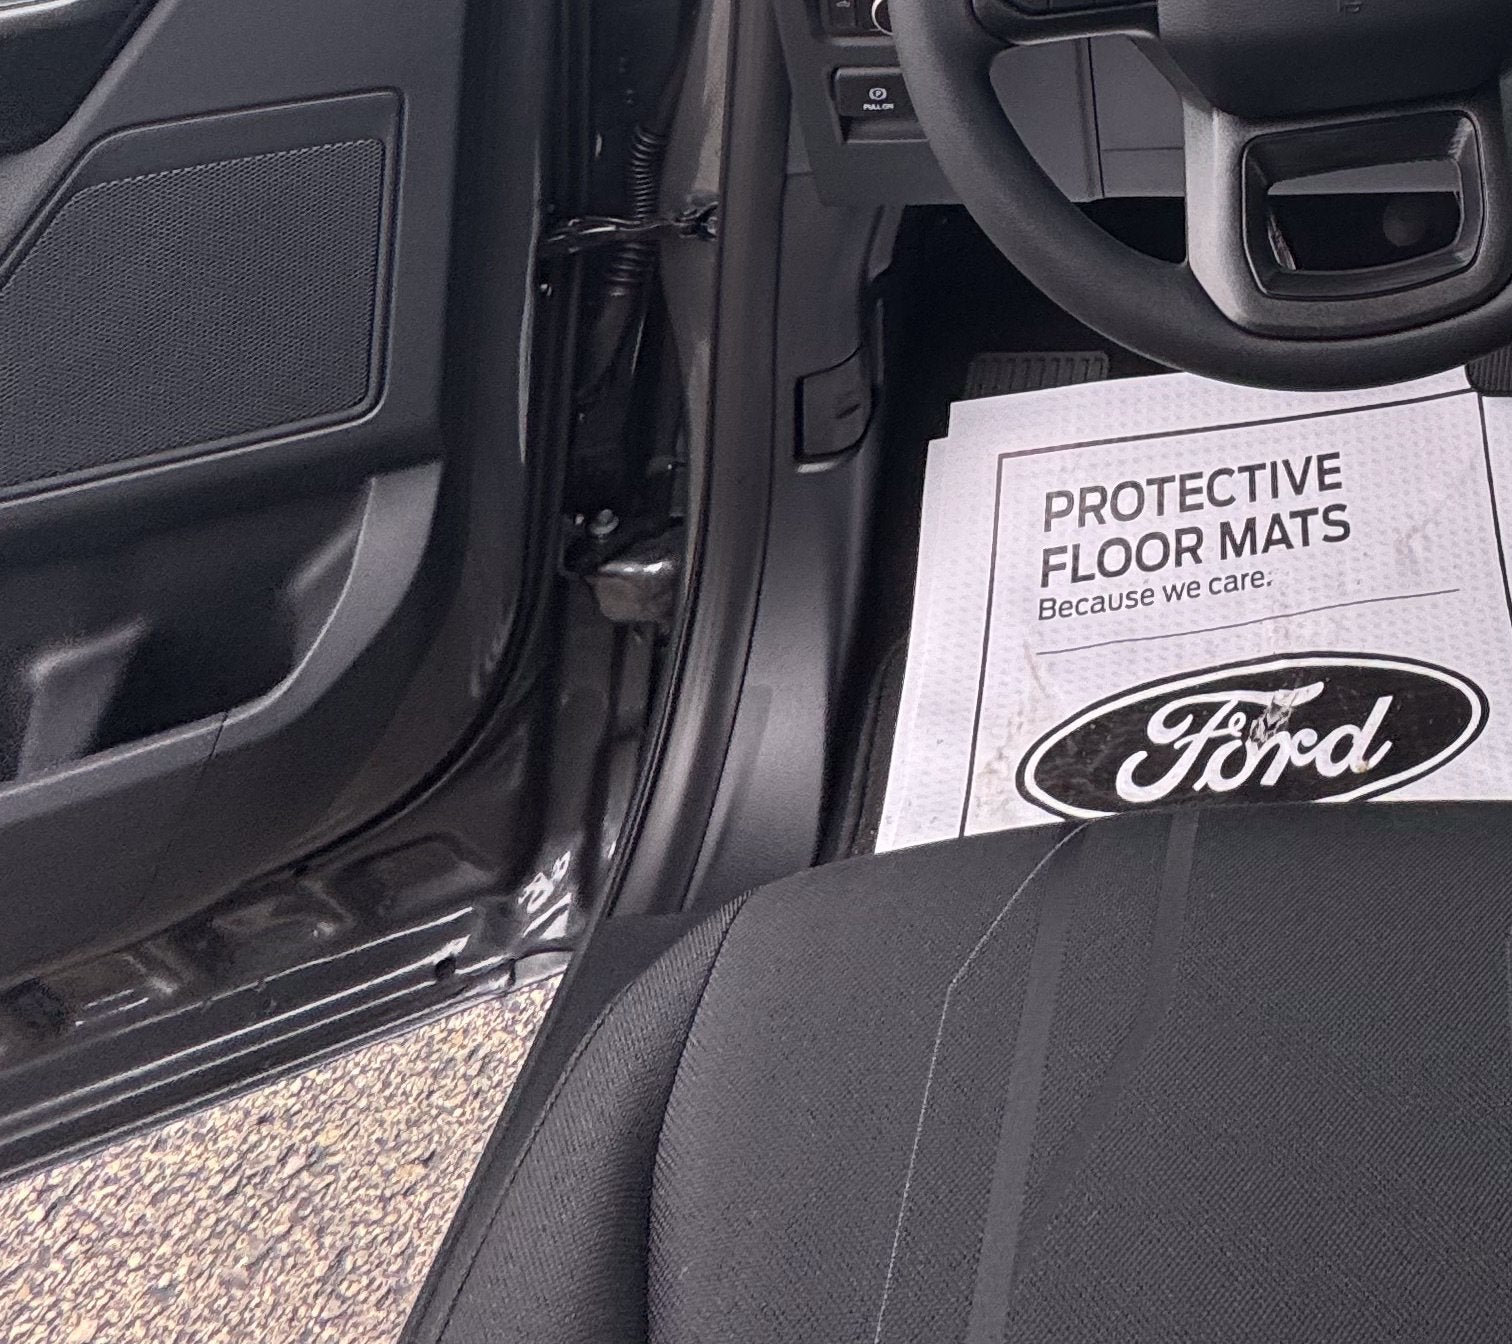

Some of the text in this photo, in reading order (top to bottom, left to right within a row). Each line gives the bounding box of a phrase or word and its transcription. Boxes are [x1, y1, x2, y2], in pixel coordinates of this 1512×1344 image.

[1043, 451, 1343, 532] PROTECTIVE
[1039, 503, 1352, 588] FLOOR MATS
[1038, 568, 1274, 621] Because we care.
[1115, 680, 1394, 804] Ford
